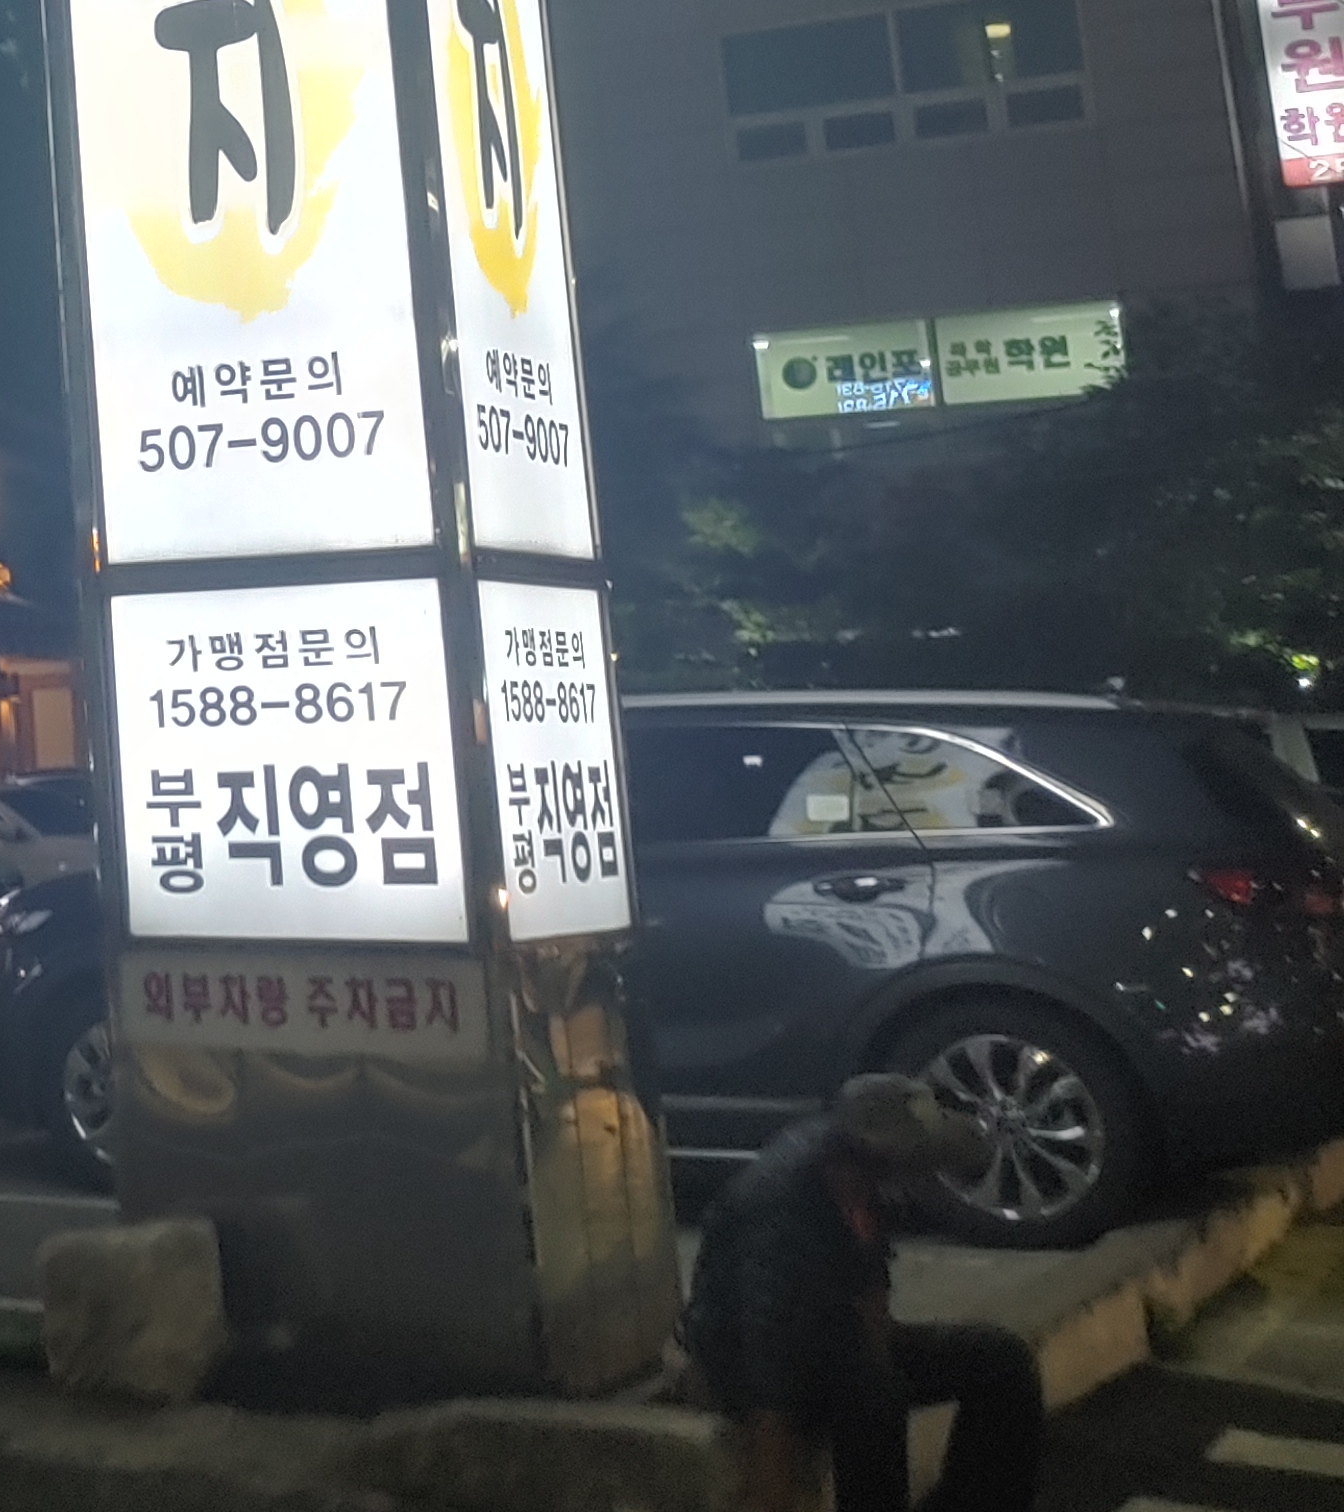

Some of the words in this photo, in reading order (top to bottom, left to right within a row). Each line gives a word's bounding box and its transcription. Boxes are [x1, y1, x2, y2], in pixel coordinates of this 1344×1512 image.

[170, 350, 344, 410] 예약문의
[484, 349, 552, 405] 예약문의
[1004, 335, 1072, 372] 학원
[137, 410, 386, 474] 507-9007
[476, 404, 570, 470] 507-9007
[165, 624, 382, 674] 가맹점문의
[504, 625, 586, 671] 가맹점문의
[148, 680, 408, 729] 1588-8617
[499, 678, 596, 726] 1588-8617
[145, 767, 206, 895] 부평
[217, 760, 439, 888] 직영점
[507, 762, 538, 896] 부평
[534, 758, 619, 884] 직영점
[143, 972, 289, 1029] 외부차량
[306, 974, 460, 1035] 주차금지
